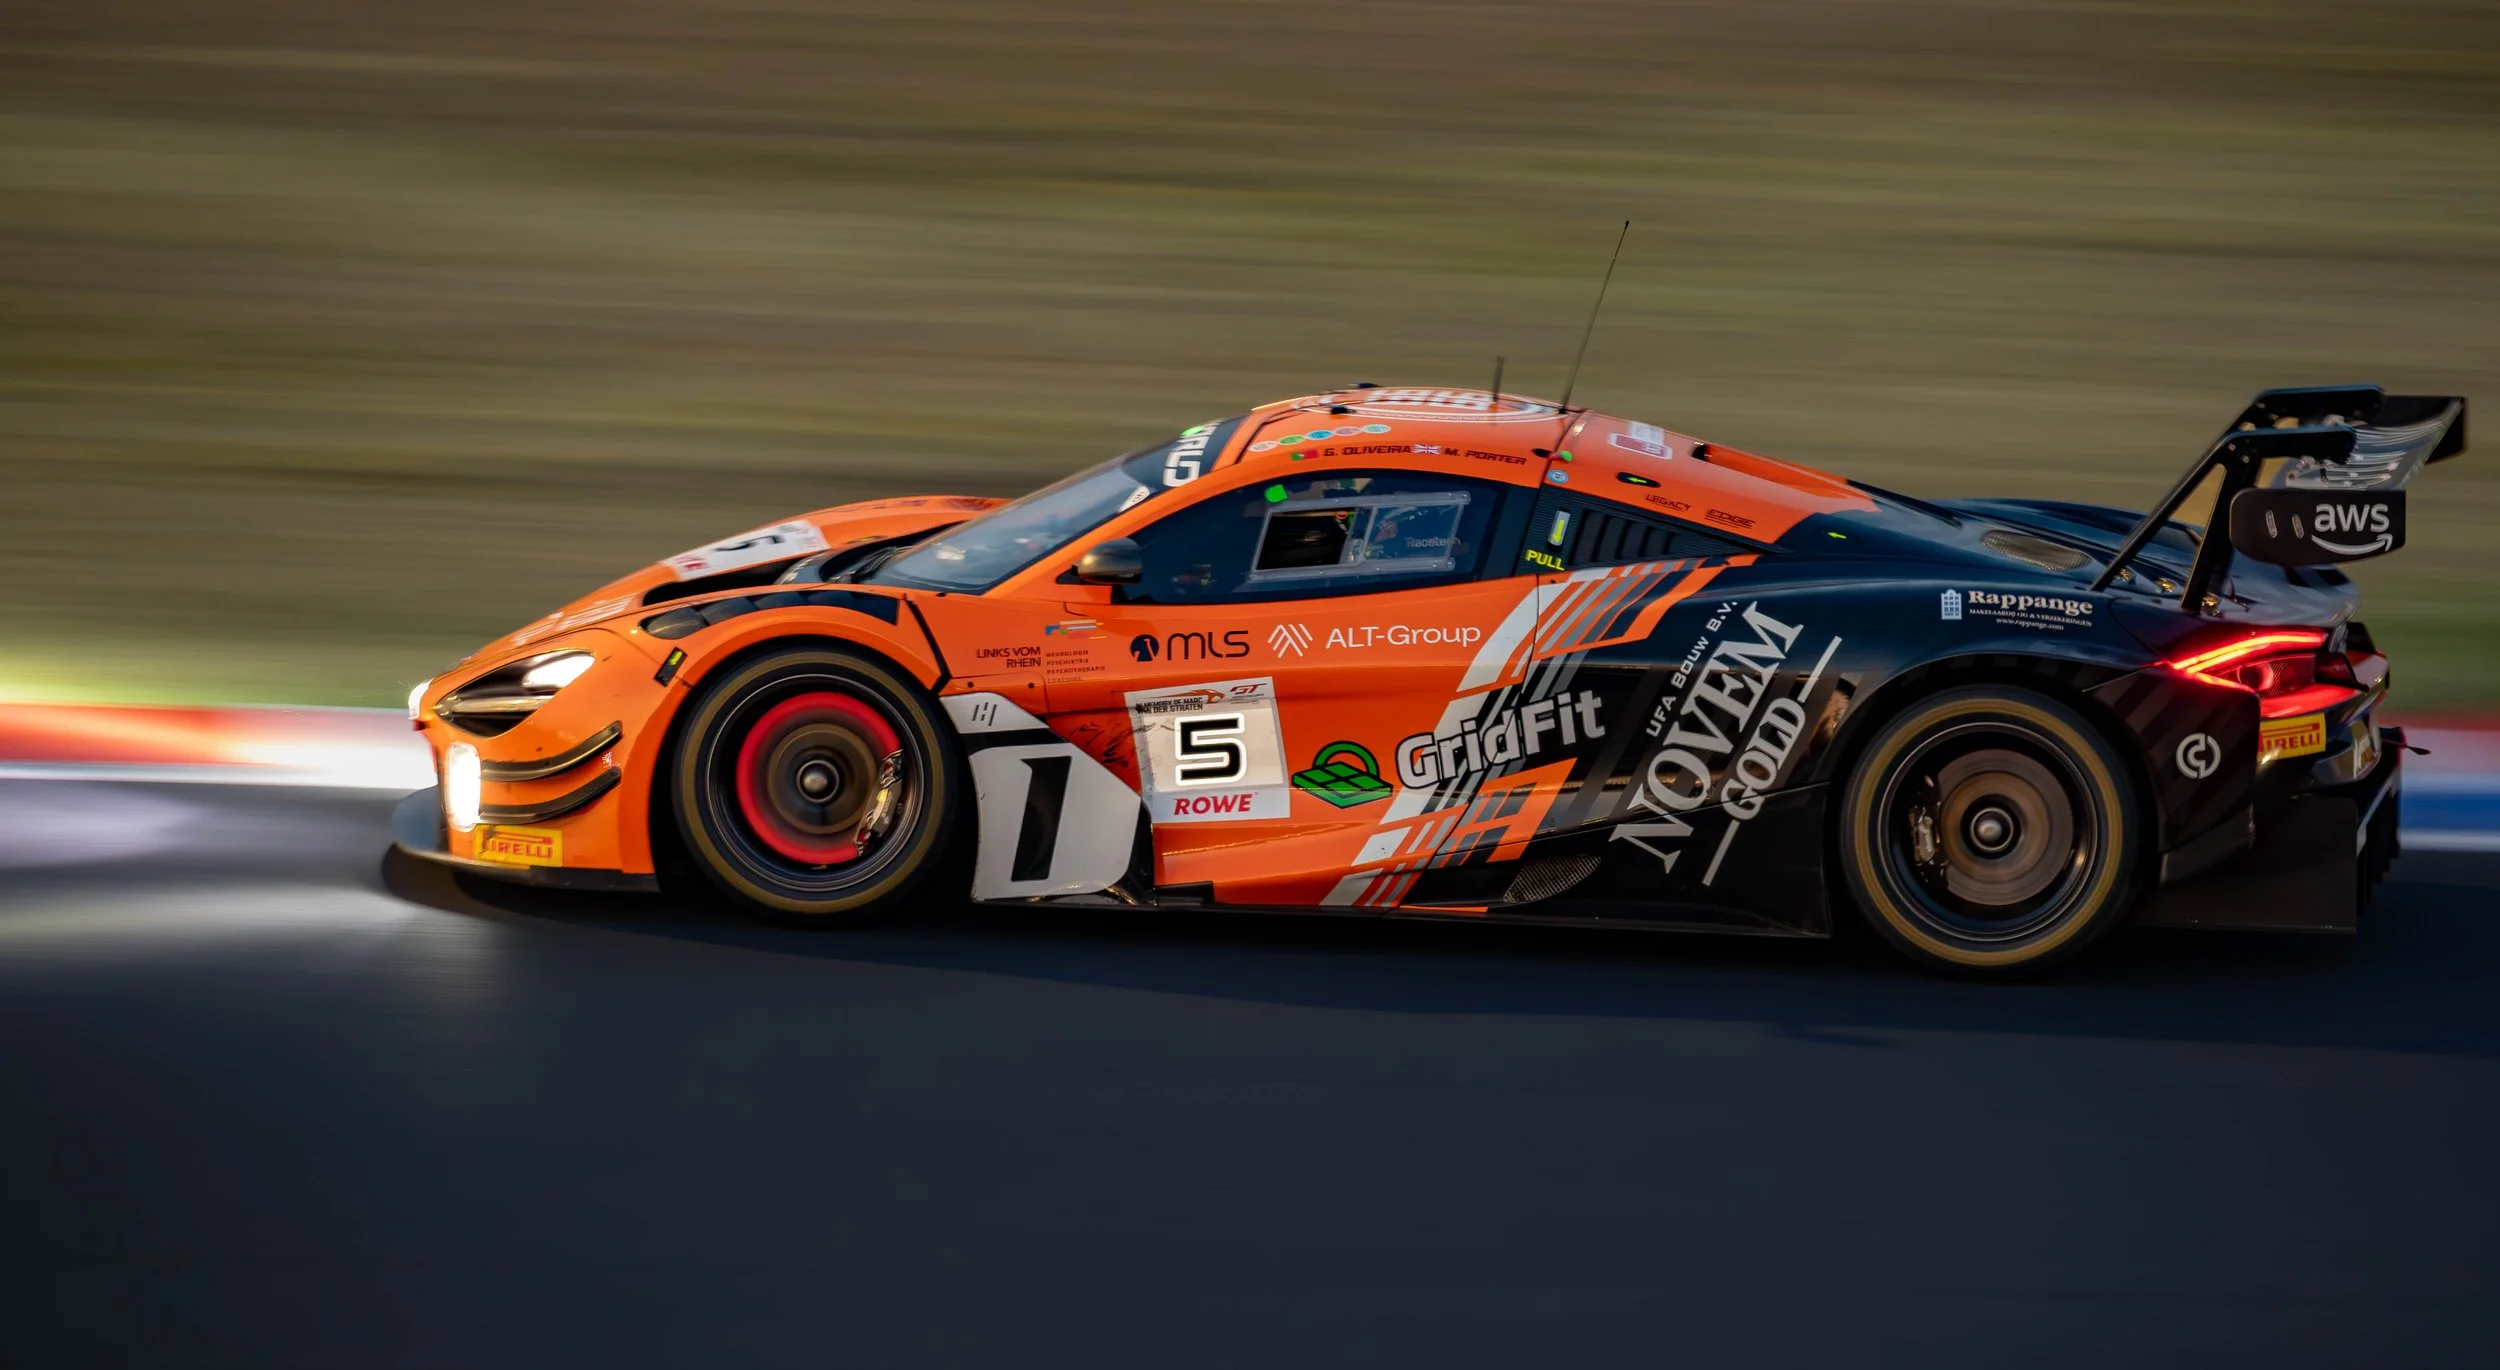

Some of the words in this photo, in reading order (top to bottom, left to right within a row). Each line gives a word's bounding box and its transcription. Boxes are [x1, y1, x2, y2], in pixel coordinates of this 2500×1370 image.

[1323, 447, 1338, 457] G.
[1342, 445, 1412, 457] OLIVEIRA
[1442, 447, 1460, 457] M.
[1465, 450, 1527, 465] PORTER
[1645, 494, 1692, 511] LEGACY
[1706, 508, 1756, 528] EDGE
[2314, 503, 2390, 532] aws
[1525, 549, 1565, 571] PULL
[1968, 590, 2093, 616] Rappange
[1325, 625, 1481, 649] ALT-Group
[977, 648, 1010, 659] LINKS
[1012, 646, 1041, 657] VOM
[1006, 657, 1041, 669] RHEIN
[1646, 695, 1676, 738] UFA
[1671, 636, 1709, 690] BOUW
[1153, 705, 1168, 713] DER
[1170, 704, 1203, 712] STRATEN
[1395, 689, 1606, 789] GridFit
[1608, 600, 1804, 875] NOVEM
[1175, 713, 1246, 786] 5
[1720, 696, 1806, 821] GOLD
[1174, 794, 1253, 815] ROWE
